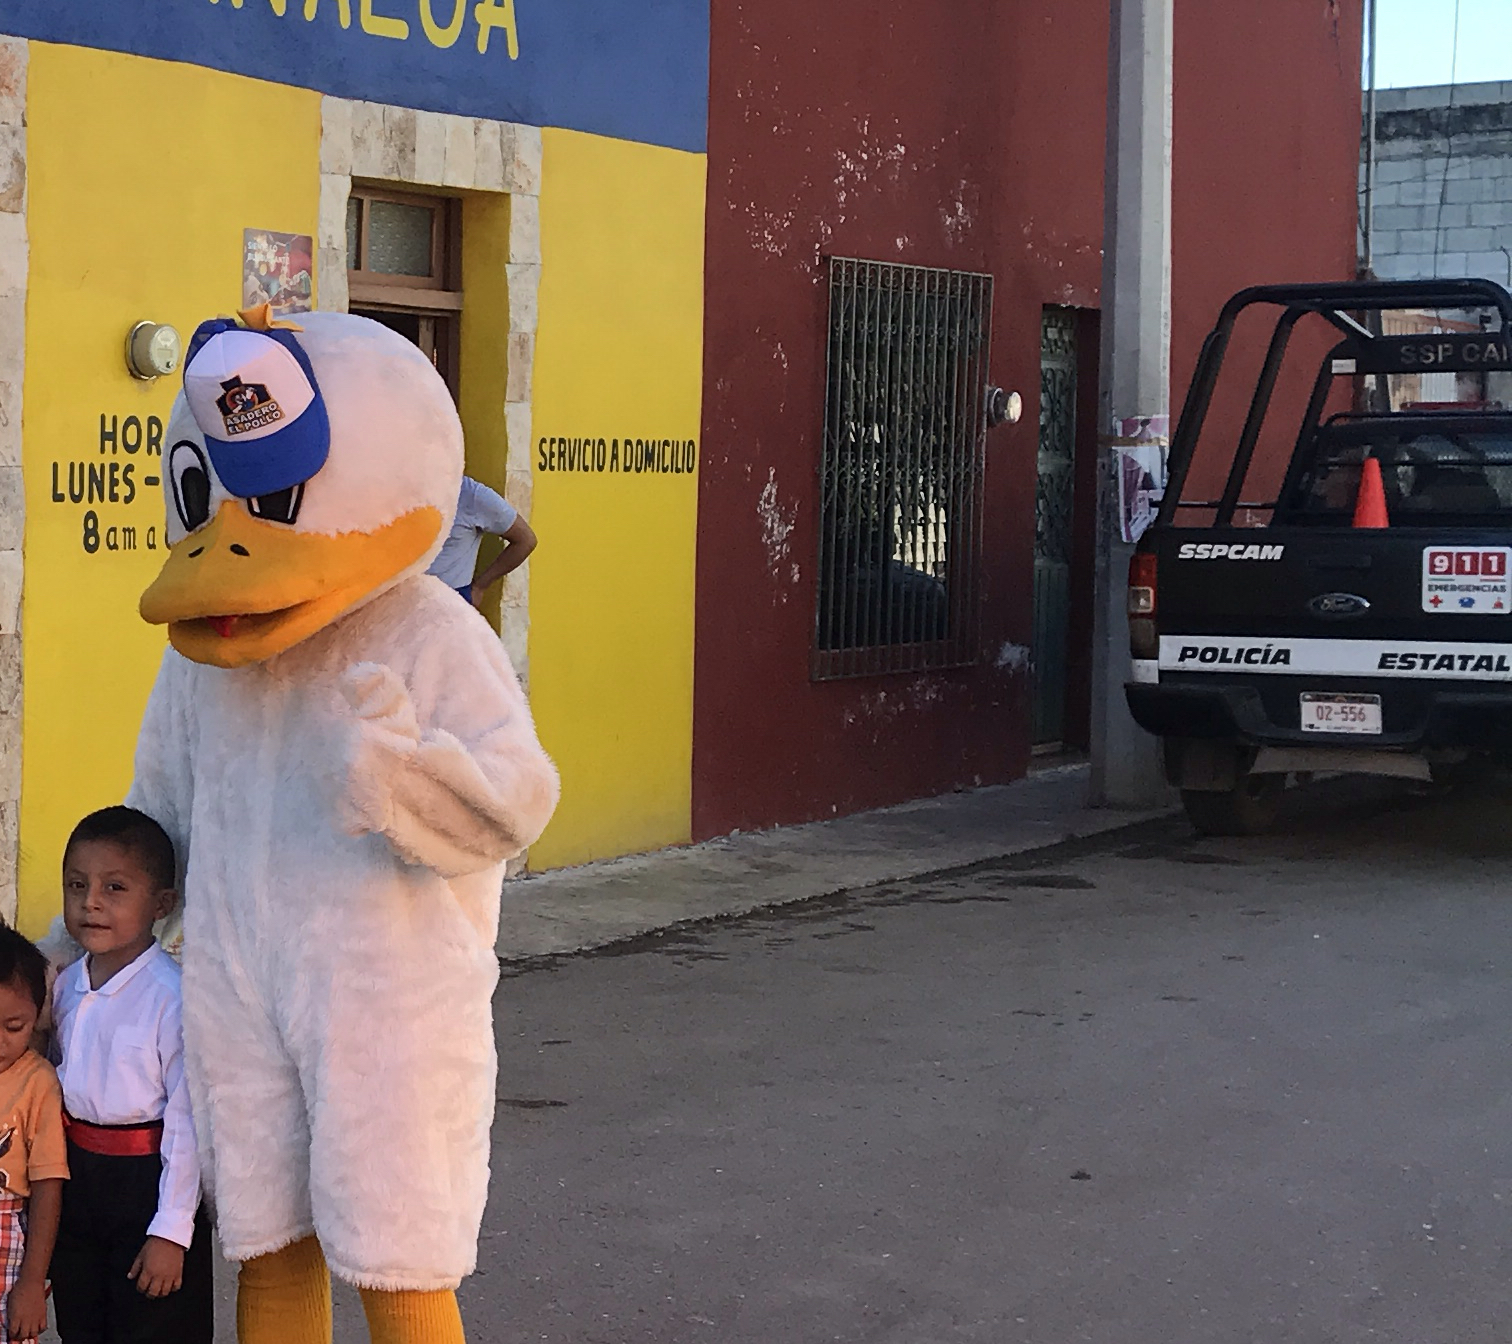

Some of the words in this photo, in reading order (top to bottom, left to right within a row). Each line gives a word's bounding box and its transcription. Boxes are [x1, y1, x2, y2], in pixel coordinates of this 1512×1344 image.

[1400, 343, 1454, 364] SSP
[226, 402, 278, 426] ASADERO
[228, 424, 243, 434] EL
[244, 410, 281, 431] POLLO
[100, 413, 163, 456] HOR
[538, 437, 607, 473] SERVICIO
[609, 438, 620, 473] A
[623, 438, 696, 474] DOMICILIO
[52, 461, 136, 504] LUNES
[1178, 543, 1285, 561] SSPCAM
[1433, 554, 1499, 573] 911
[1178, 644, 1291, 666] POLICÍA
[1377, 652, 1511, 672] ESTATAL
[1316, 705, 1366, 723] 02-556
